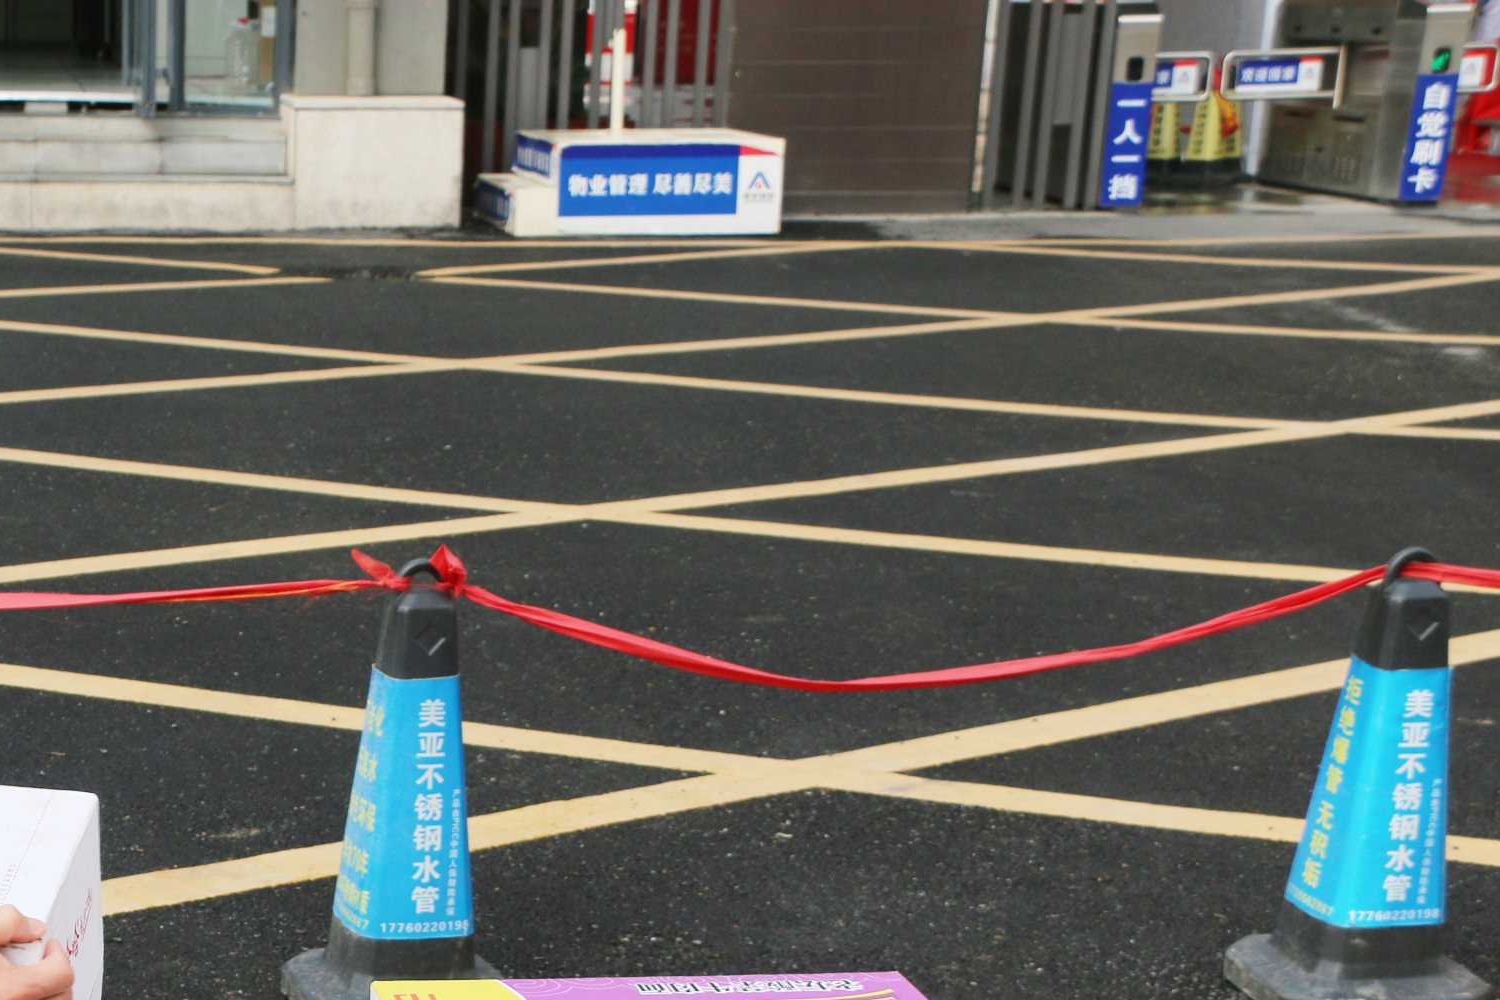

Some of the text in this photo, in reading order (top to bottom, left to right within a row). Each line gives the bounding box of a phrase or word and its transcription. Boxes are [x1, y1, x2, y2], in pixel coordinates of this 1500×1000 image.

[568, 172, 733, 196] 物业管理 尽善尽美
[1407, 81, 1454, 194] 自觉刷卡
[410, 698, 447, 915] 美亚不锈钢水管
[1382, 688, 1436, 903] 美亚不锈钢水管
[379, 919, 470, 934] 17760220198
